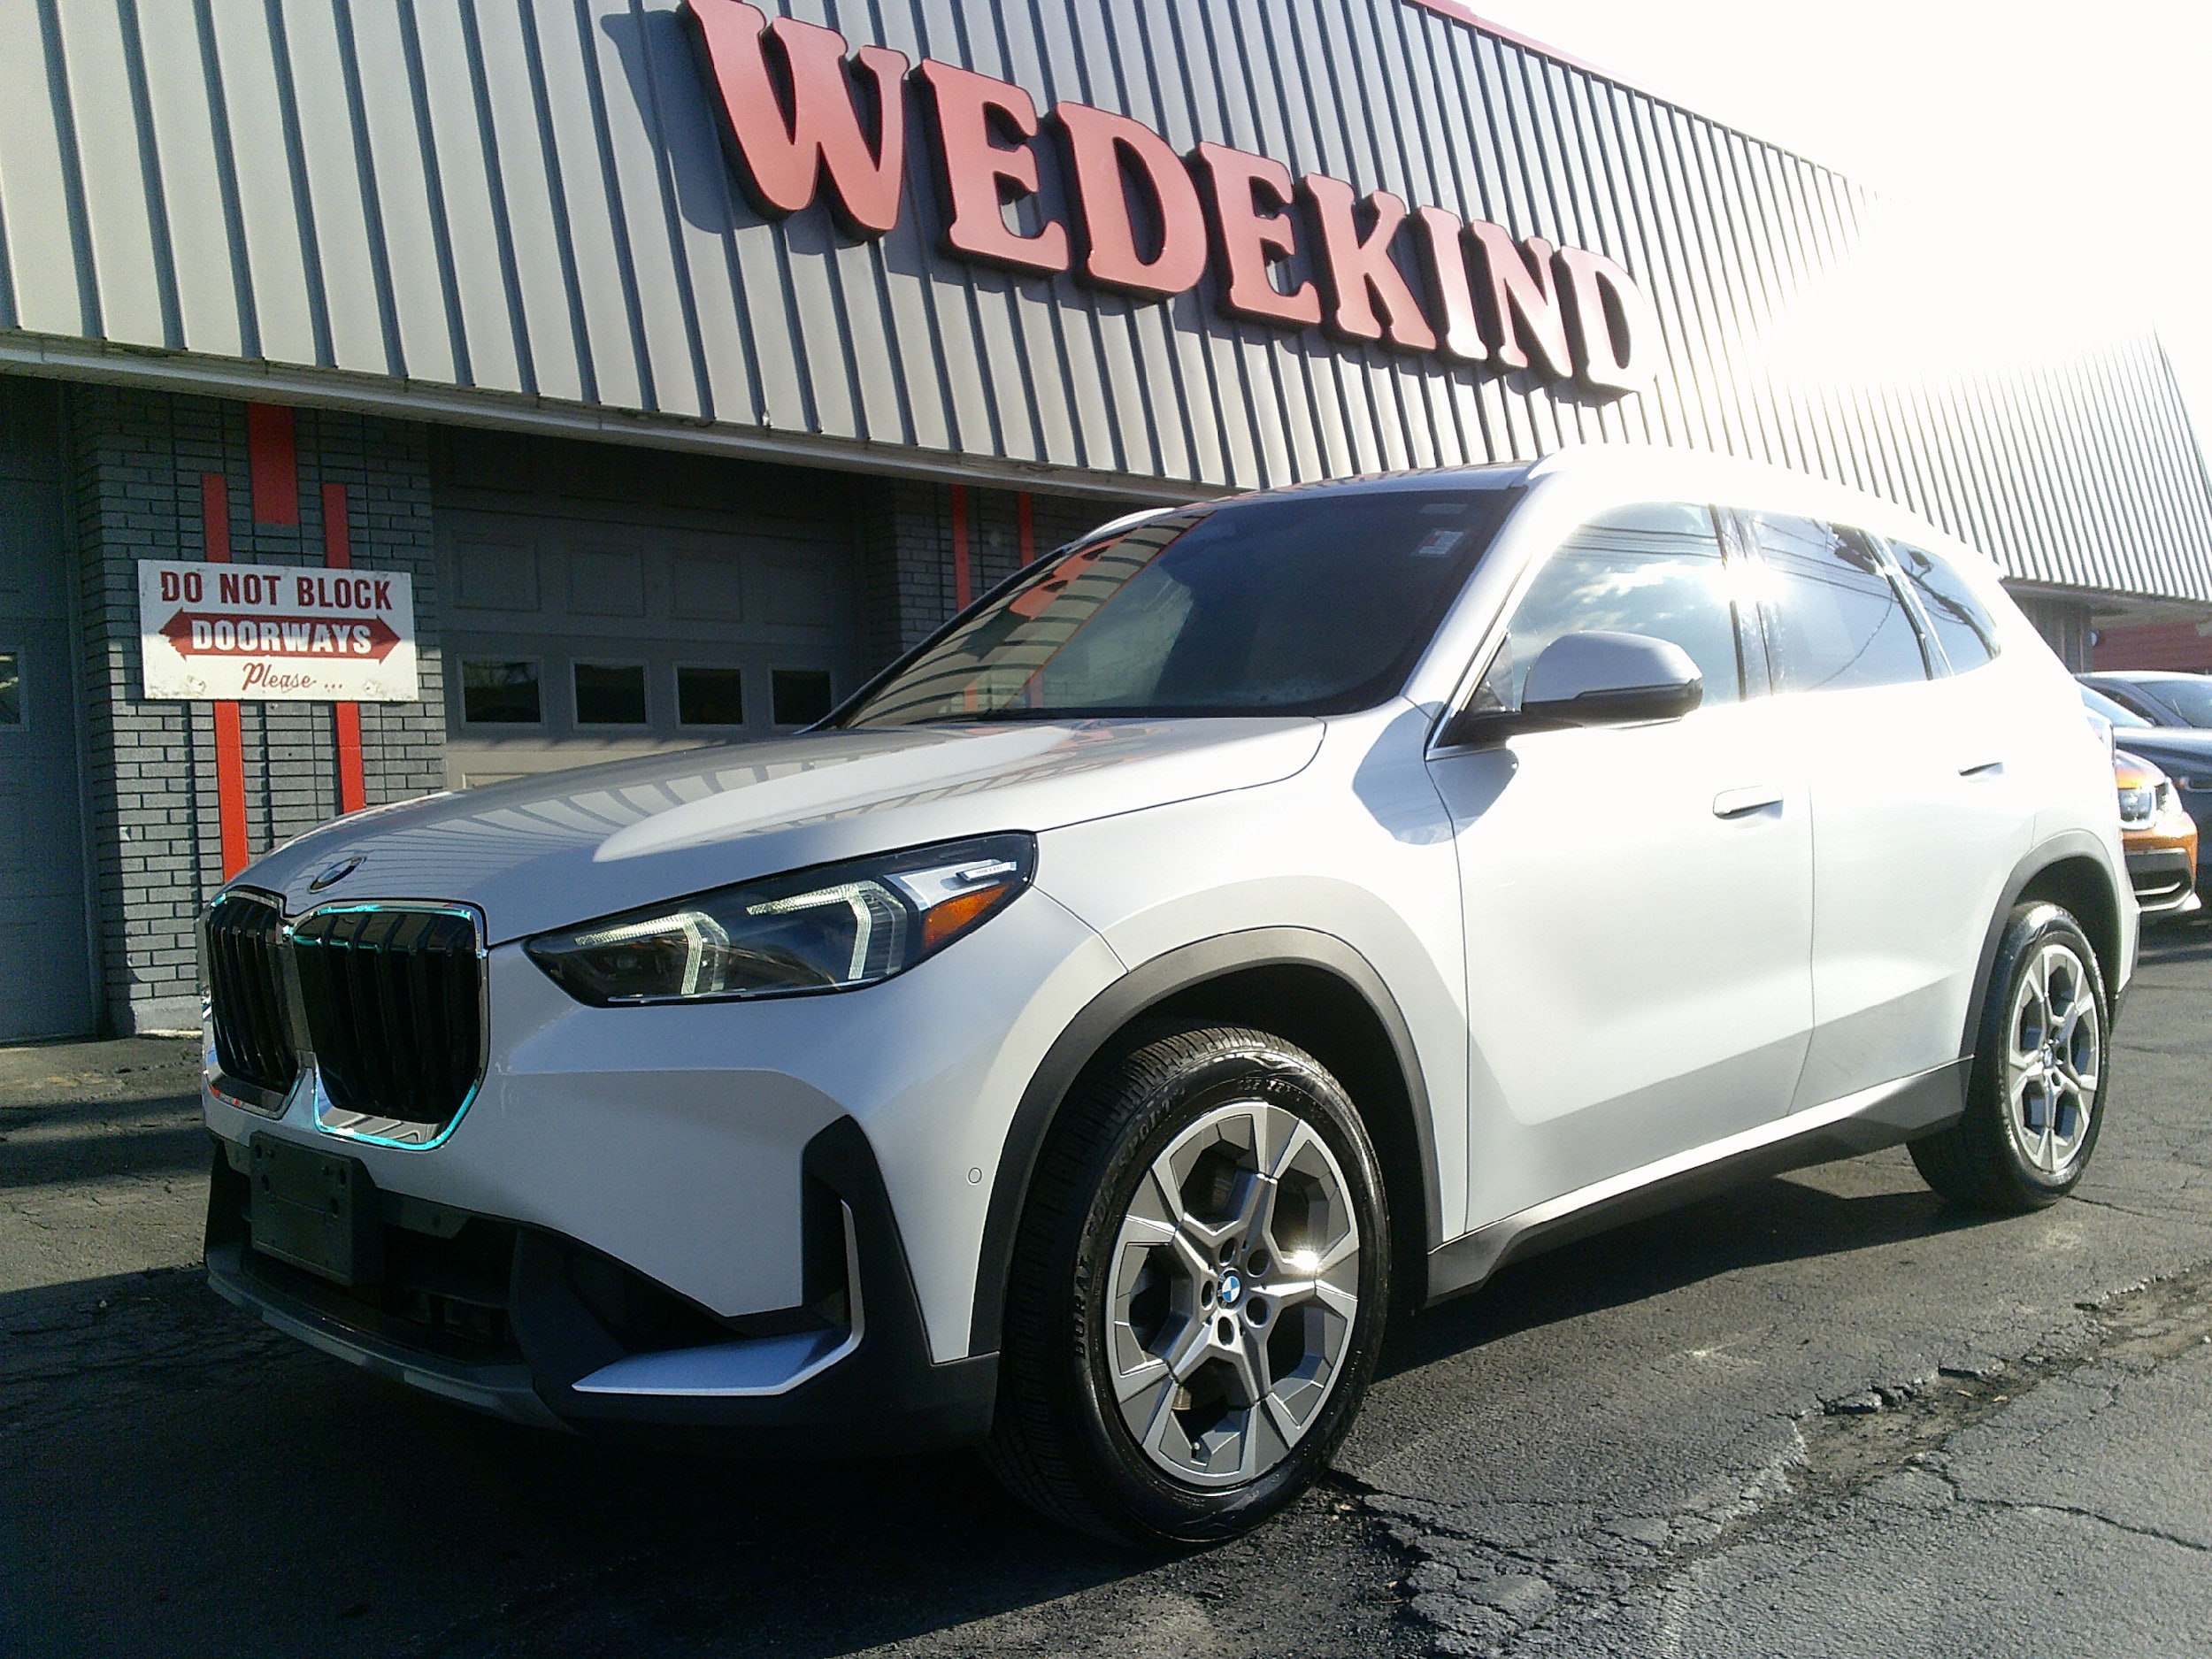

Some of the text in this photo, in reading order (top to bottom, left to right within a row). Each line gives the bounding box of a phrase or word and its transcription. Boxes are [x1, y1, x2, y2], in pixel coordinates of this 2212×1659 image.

[681, 0, 1644, 389] WEDEKIND
[160, 571, 392, 610] DO NOT BLOCK
[191, 619, 372, 653] DOORWAYS
